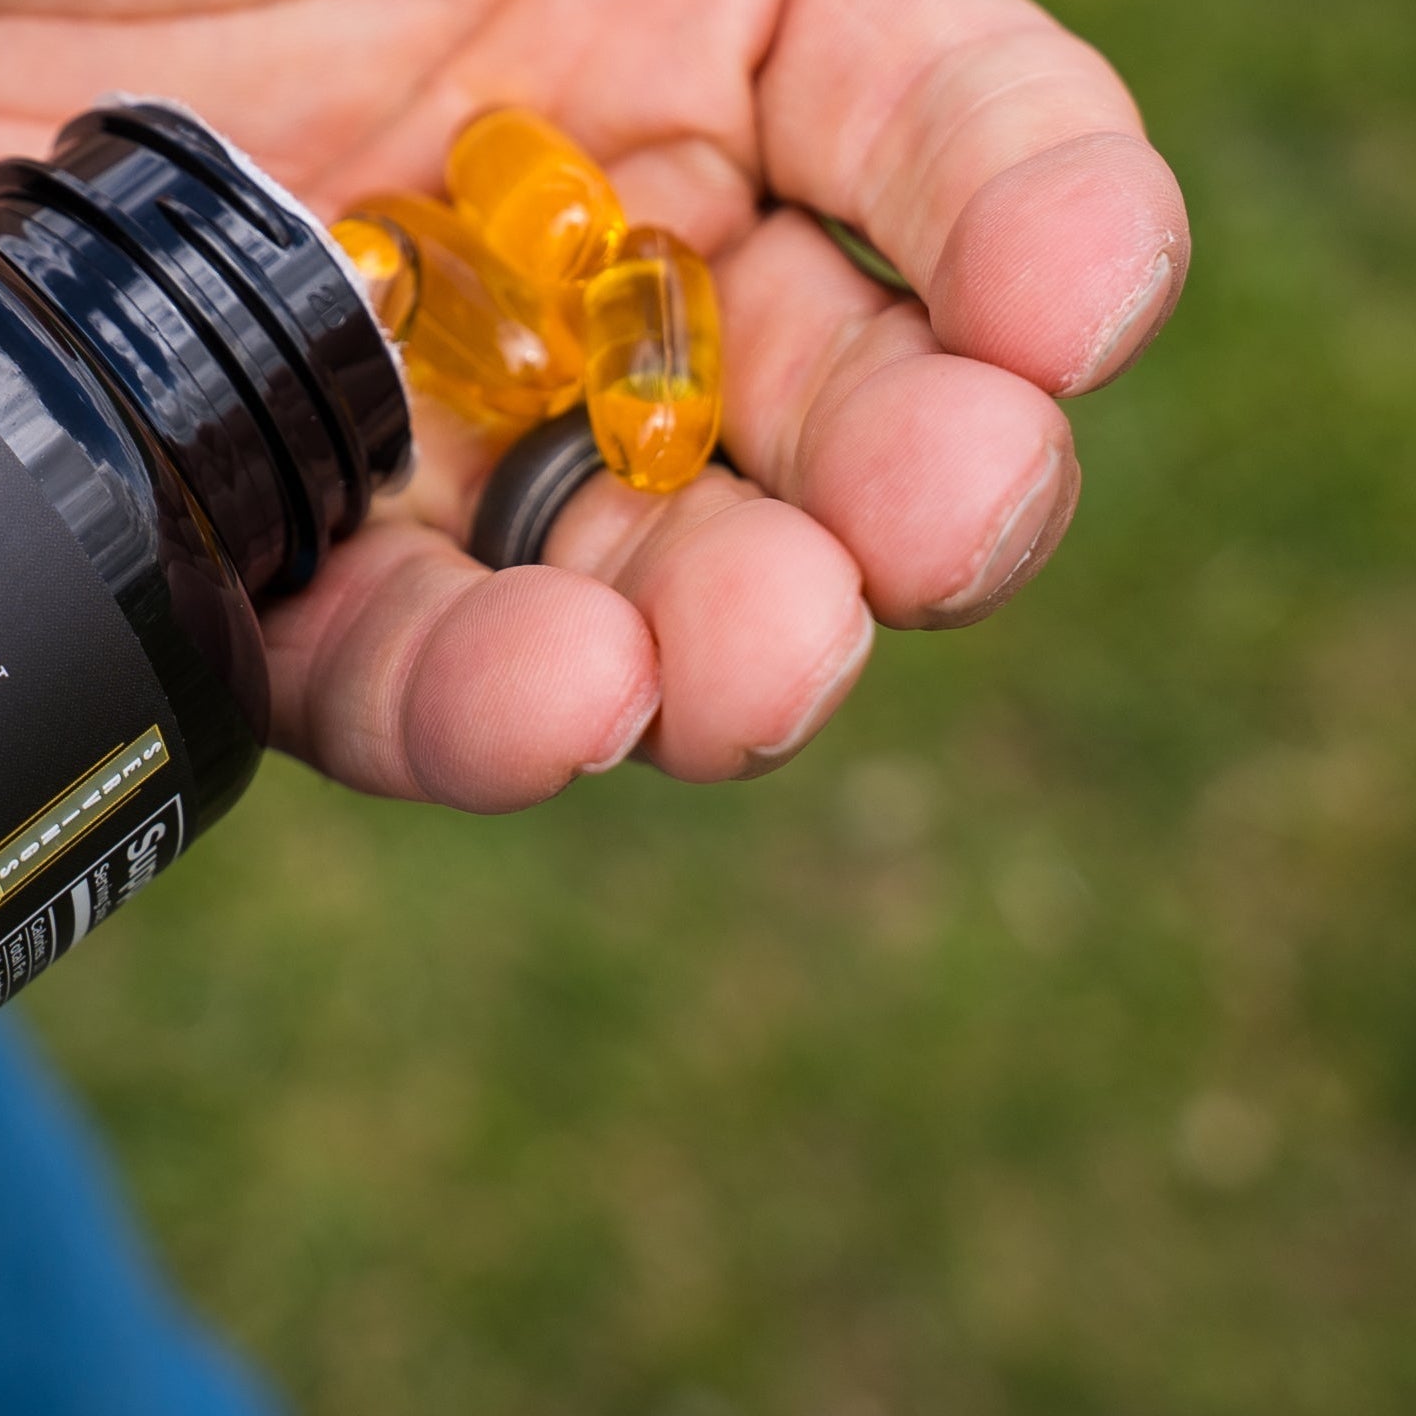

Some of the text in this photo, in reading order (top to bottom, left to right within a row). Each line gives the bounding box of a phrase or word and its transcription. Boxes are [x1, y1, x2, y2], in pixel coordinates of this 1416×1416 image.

[0, 741, 162, 879] SERVINGS
[93, 862, 112, 910] Serving
[9, 933, 26, 982] Total Fat
[31, 916, 47, 961] Calories
